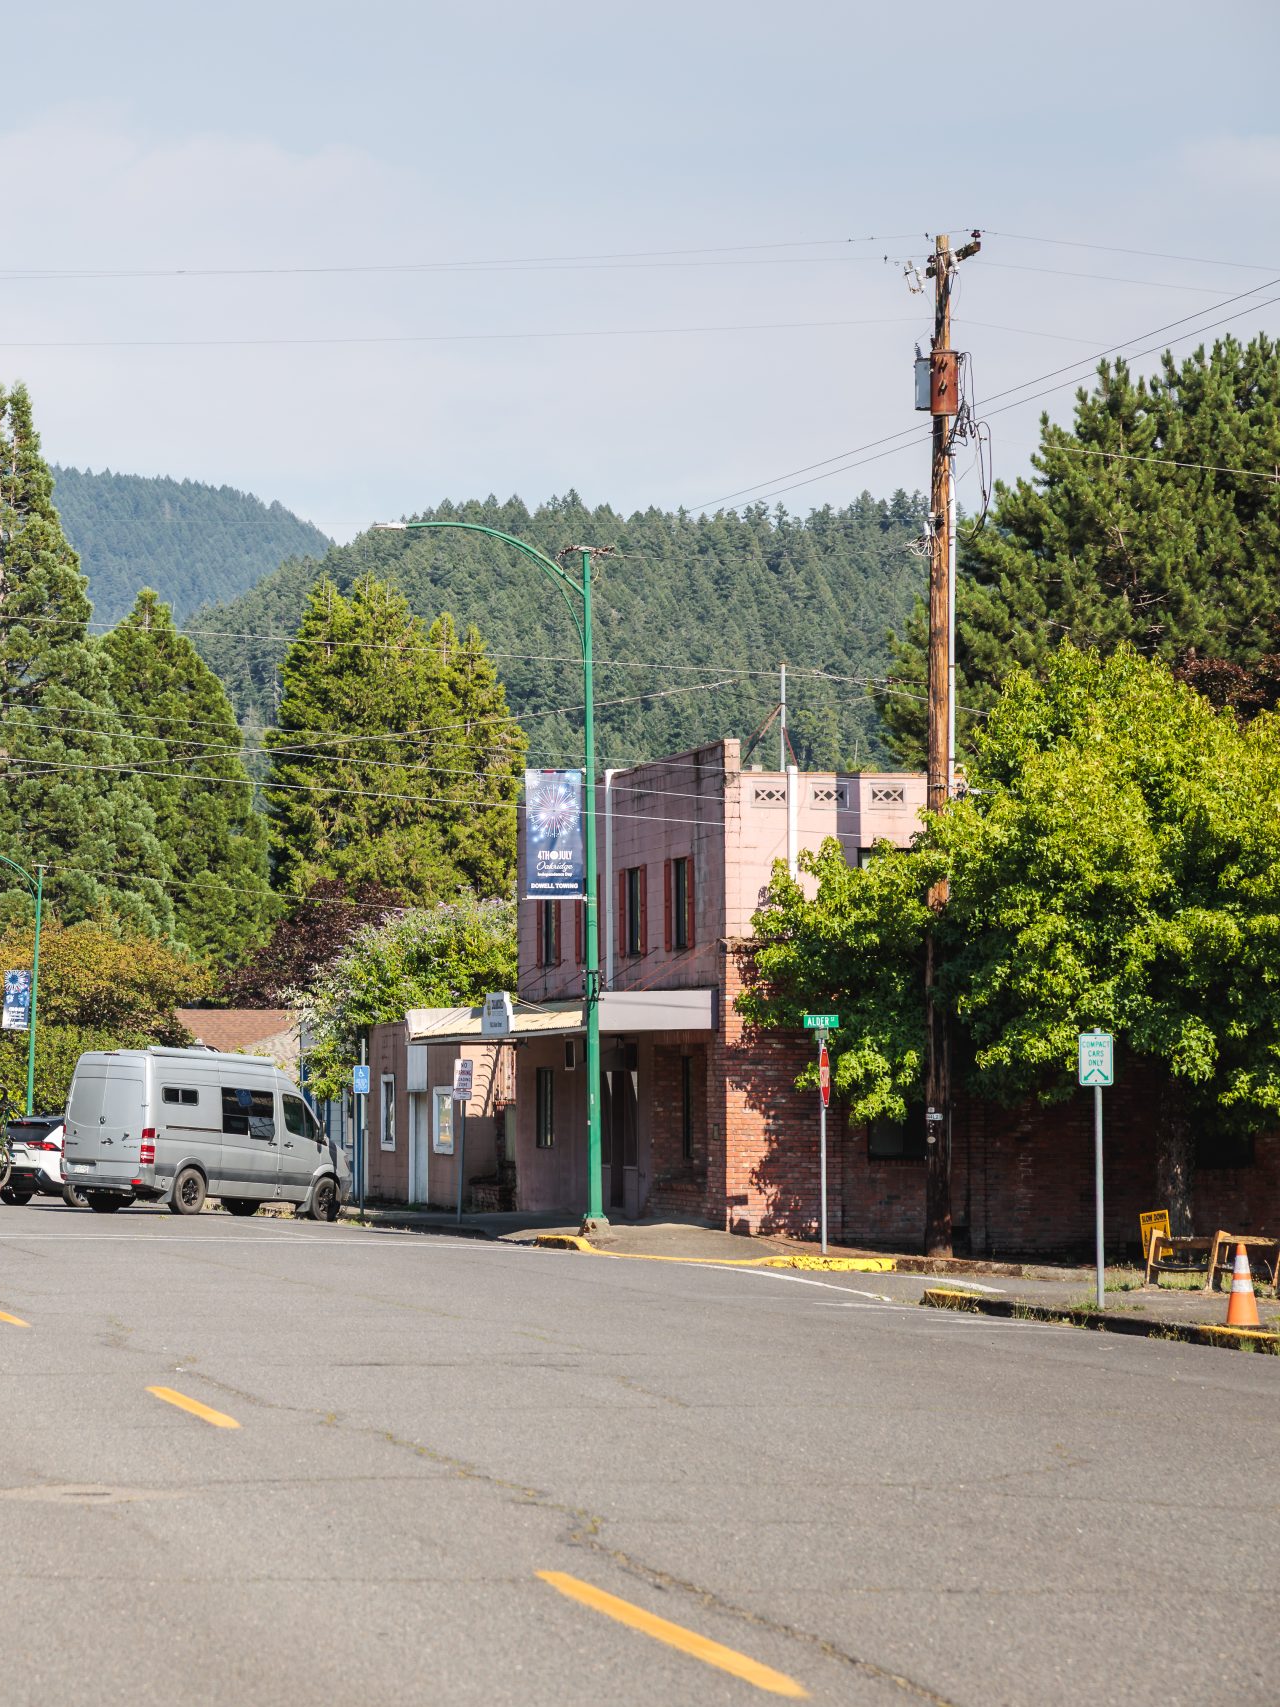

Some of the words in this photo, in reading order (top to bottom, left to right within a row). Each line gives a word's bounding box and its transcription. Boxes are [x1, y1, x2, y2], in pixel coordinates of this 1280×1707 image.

[537, 850, 550, 860] 4TH
[558, 850, 573, 860] JULY
[807, 1016, 830, 1026] ALDER
